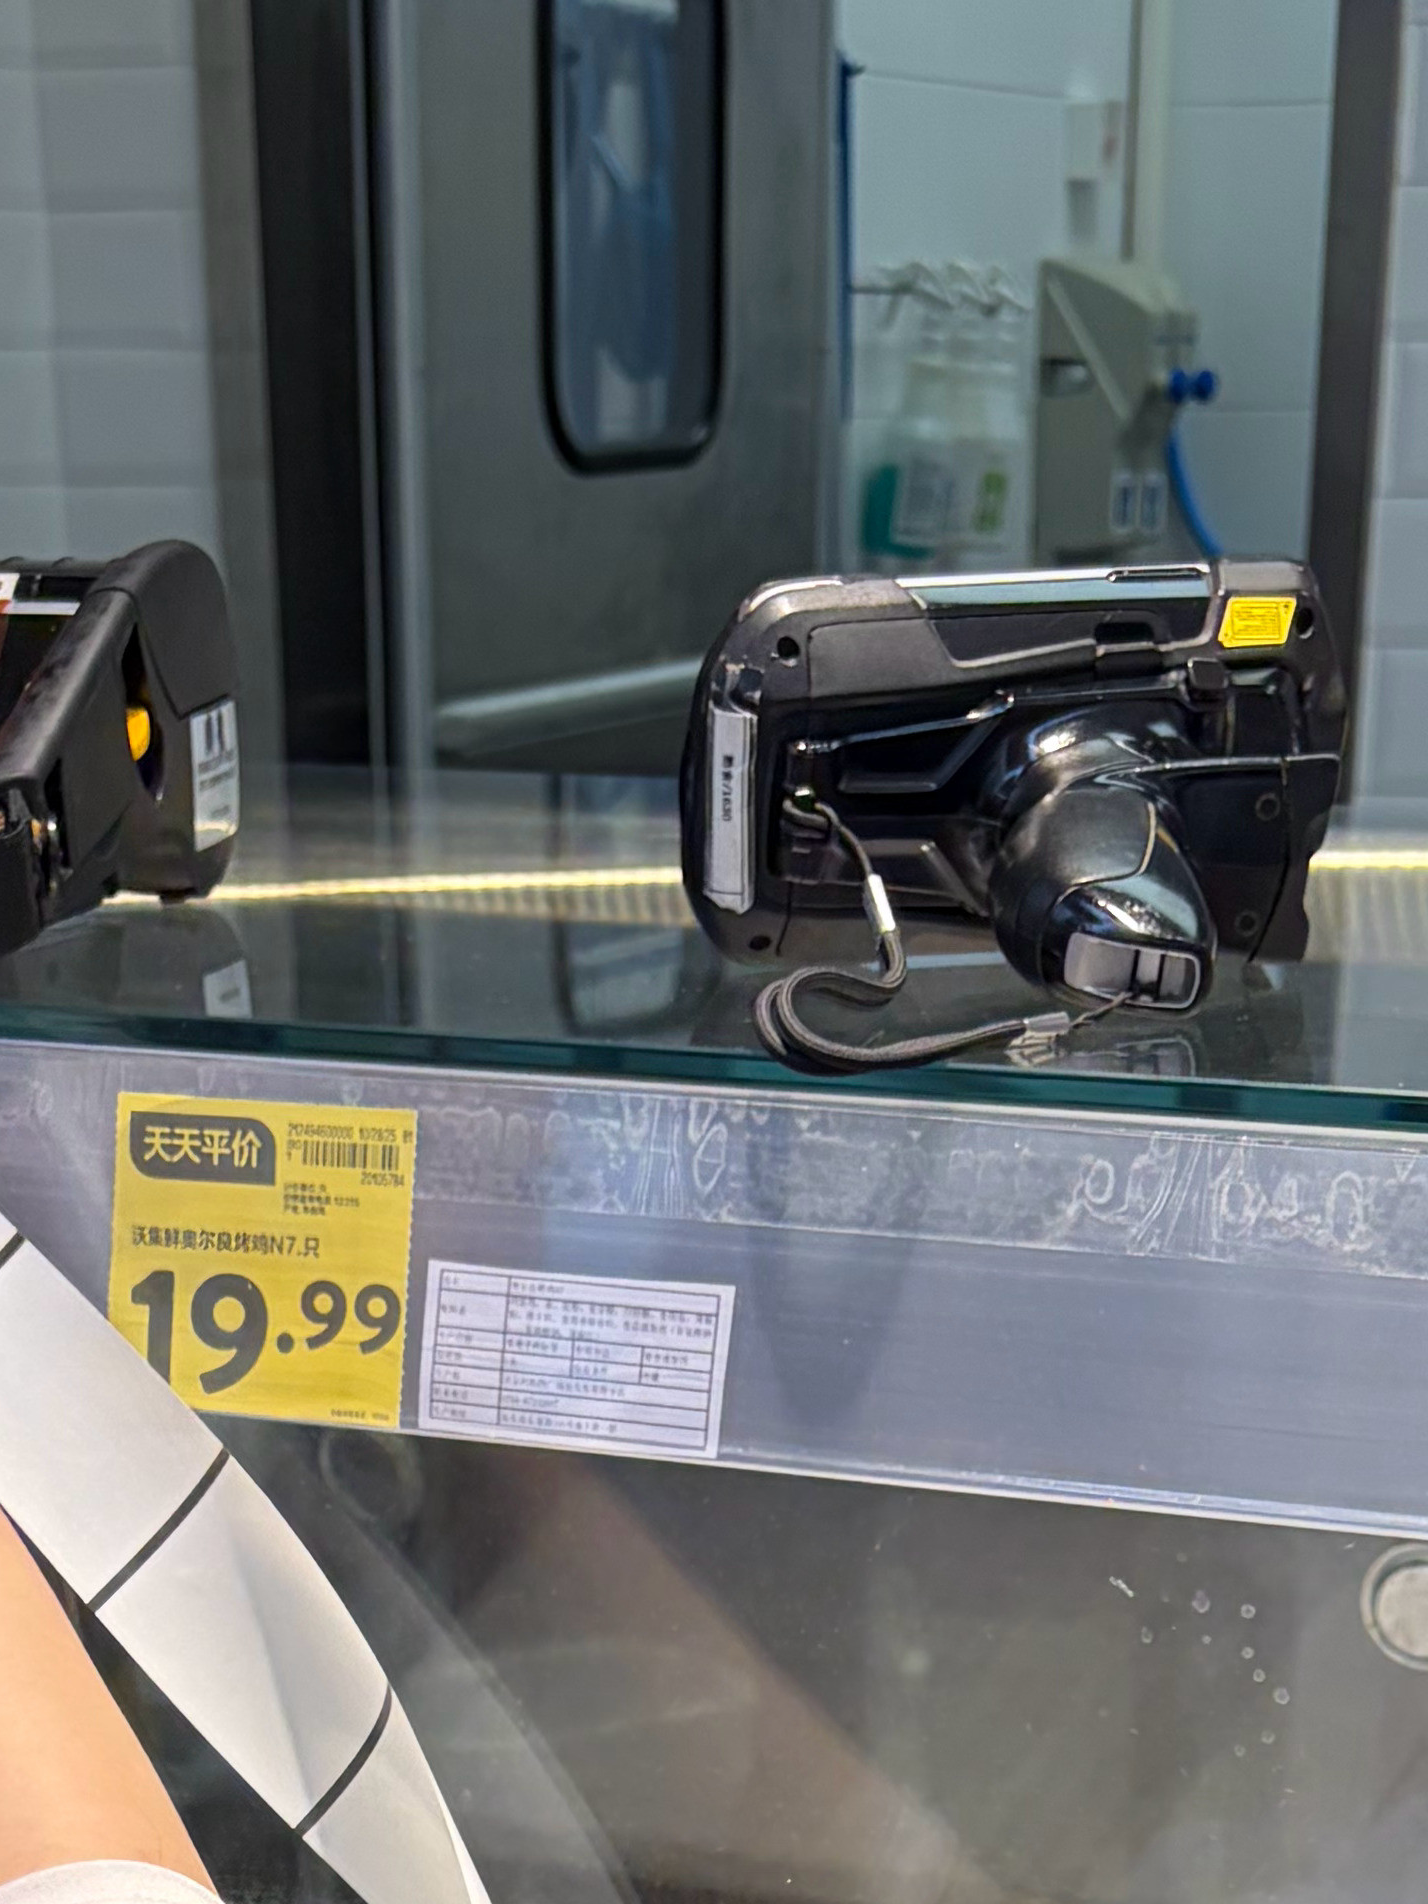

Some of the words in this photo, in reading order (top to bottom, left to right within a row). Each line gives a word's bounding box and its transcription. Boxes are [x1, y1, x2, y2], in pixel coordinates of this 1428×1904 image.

[141, 1125, 263, 1167] 天天平价
[131, 1270, 401, 1394] 19.99
